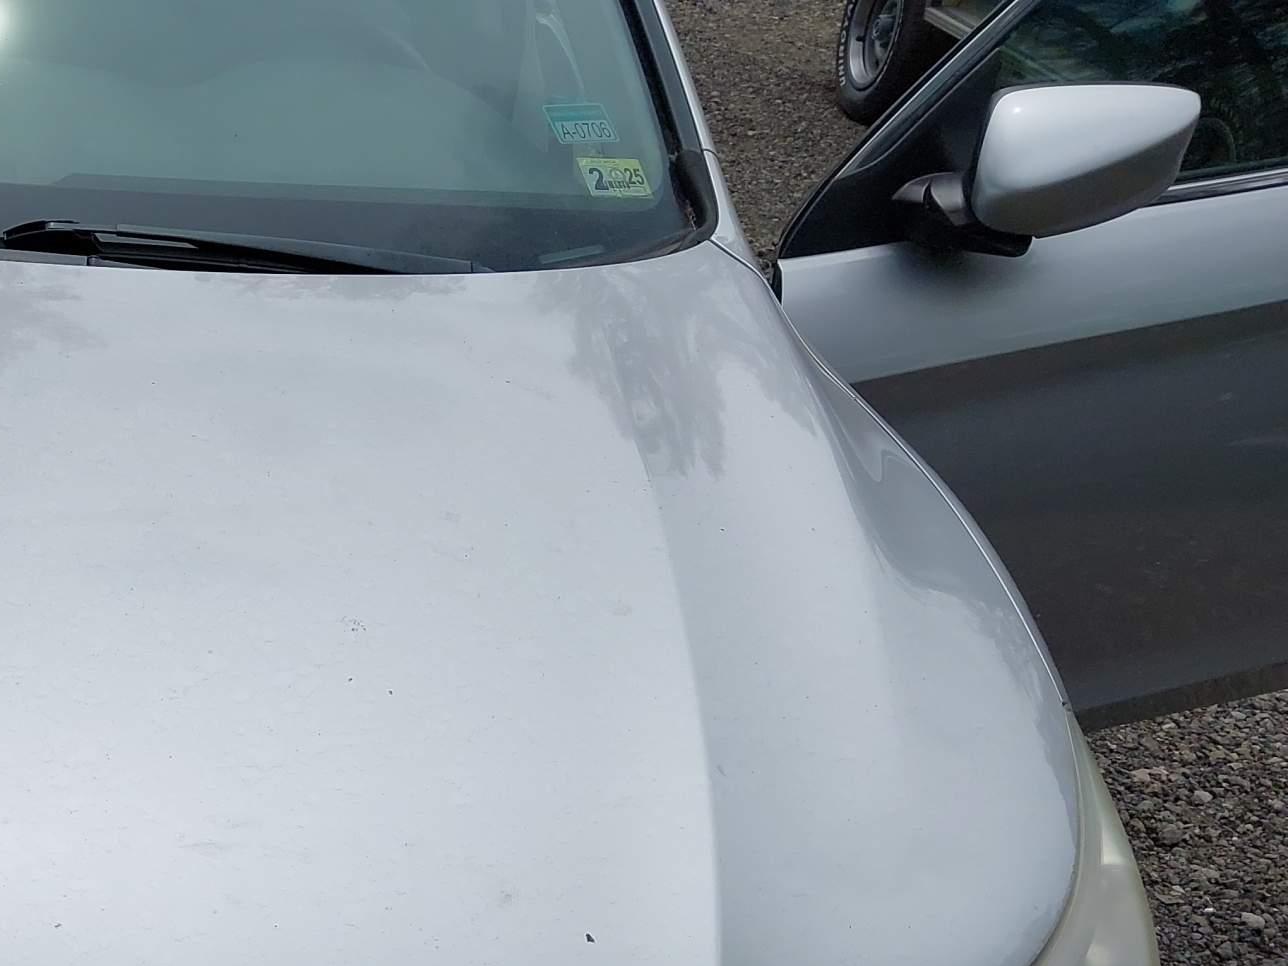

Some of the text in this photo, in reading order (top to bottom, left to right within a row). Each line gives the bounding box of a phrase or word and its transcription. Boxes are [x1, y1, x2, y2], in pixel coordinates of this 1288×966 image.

[838, 0, 855, 86] UNIROYA
[561, 121, 612, 139] A-0706
[588, 167, 610, 191] 2
[623, 167, 646, 186] 25
